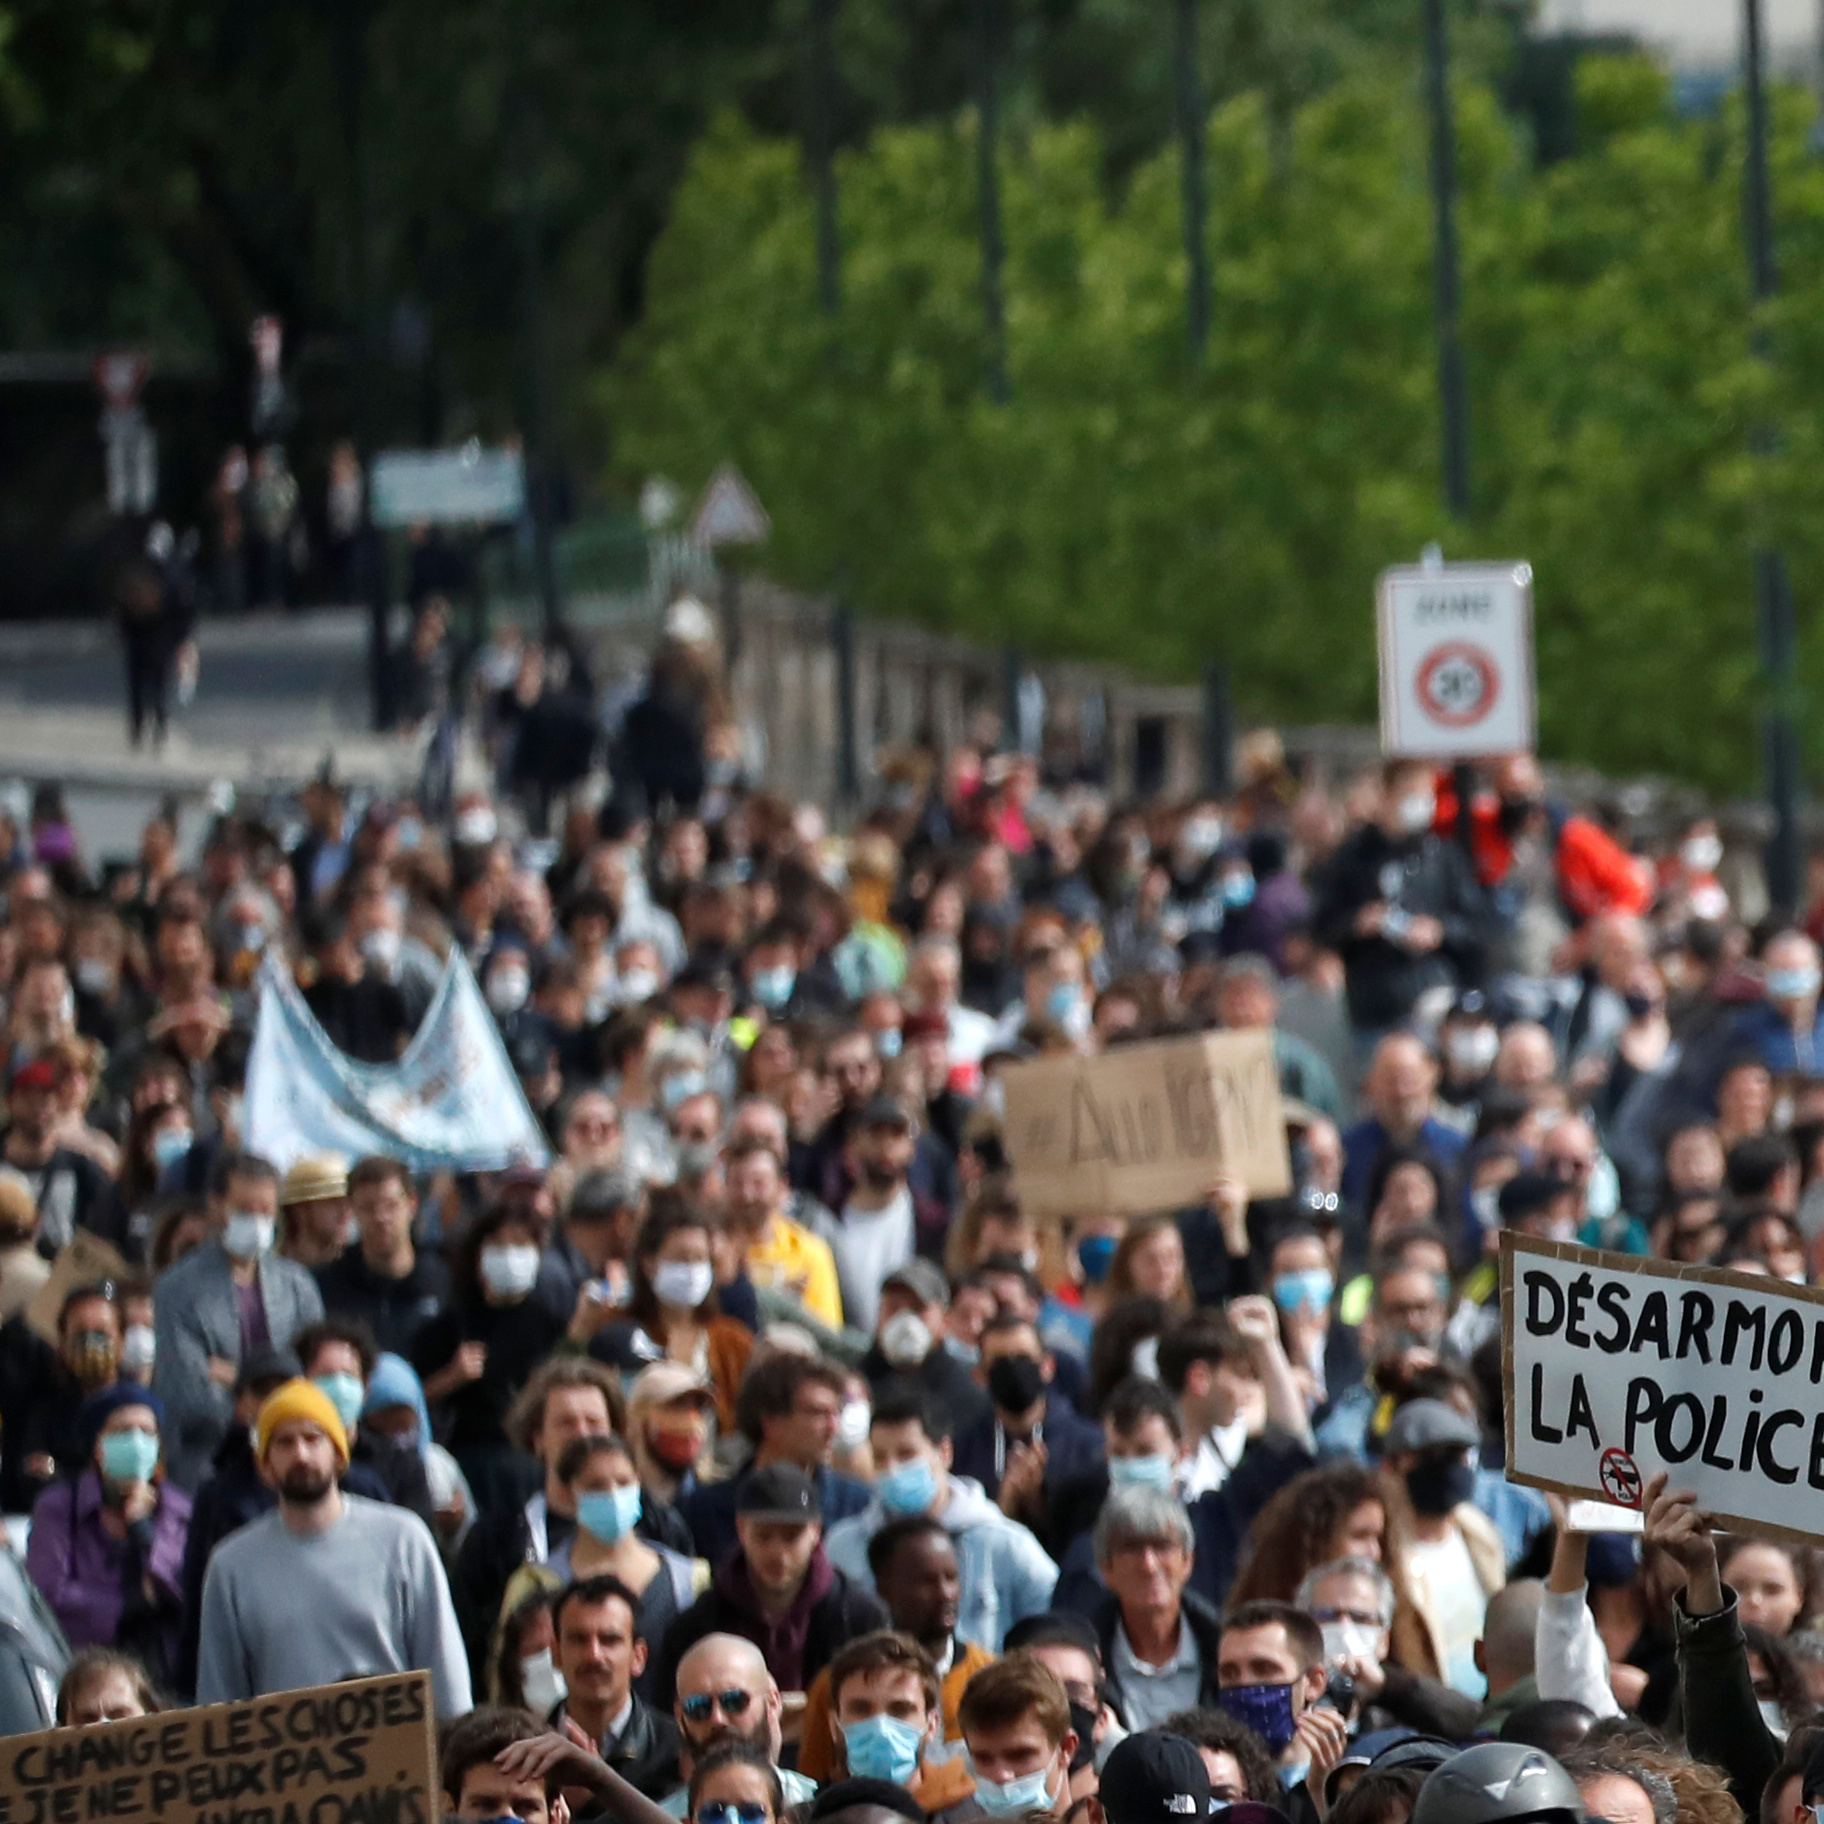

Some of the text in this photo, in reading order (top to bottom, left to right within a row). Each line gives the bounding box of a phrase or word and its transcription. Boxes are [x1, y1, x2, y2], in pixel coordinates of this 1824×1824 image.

[1531, 1363, 1600, 1451] LA
[12, 1679, 425, 1786] CHANGE LES CHOSES
[87, 1775, 144, 1820] NE
[152, 1759, 266, 1816] PEUX
[271, 1736, 370, 1794] PAS
